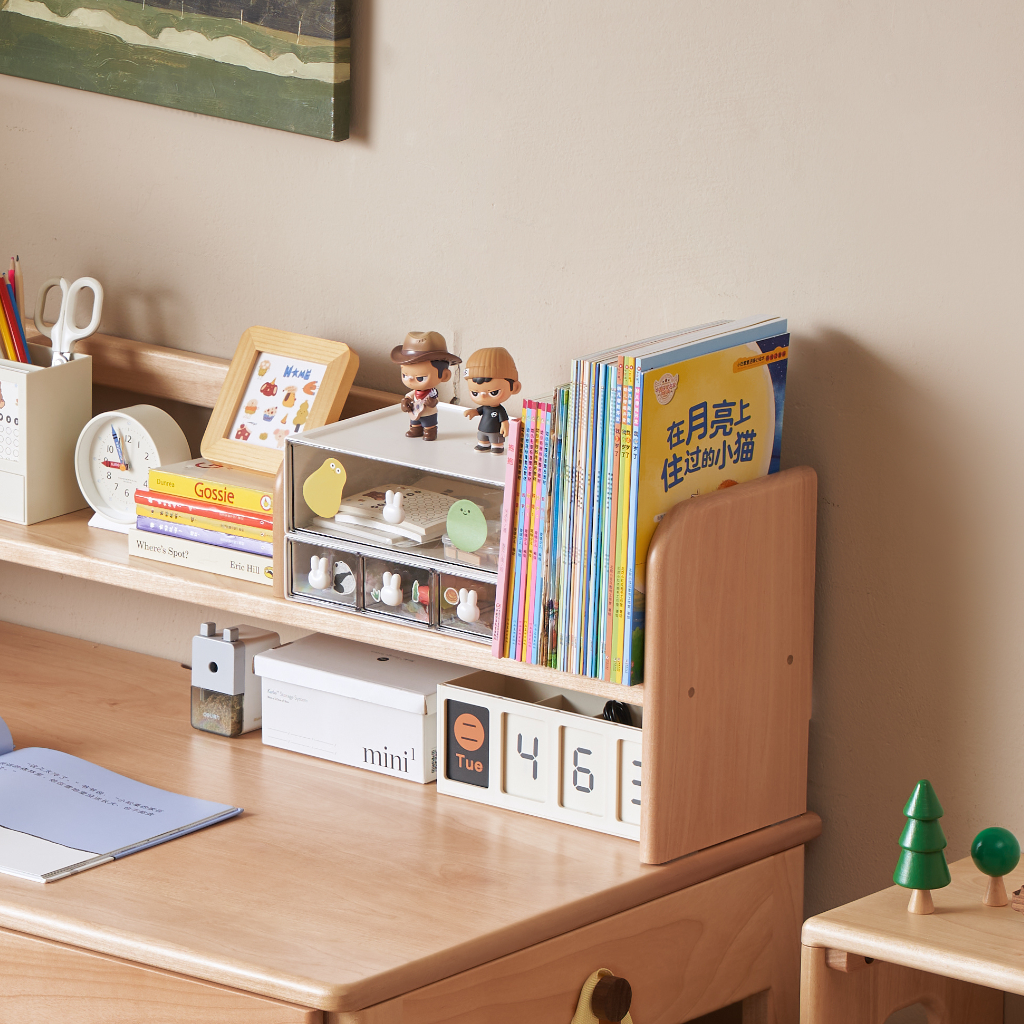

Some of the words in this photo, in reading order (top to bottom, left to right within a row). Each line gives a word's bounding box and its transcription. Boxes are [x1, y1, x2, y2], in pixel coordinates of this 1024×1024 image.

[666, 399, 752, 450] 在月亮上
[661, 429, 757, 493] 住过的小猫
[193, 482, 235, 504] Gossie
[136, 539, 167, 555] Where's
[168, 546, 189, 560] Spot?
[230, 560, 245, 572] Eric
[246, 564, 260, 575] Hill
[362, 746, 409, 773] mini
[455, 752, 484, 774] Tue
[516, 732, 538, 781] 4
[572, 746, 595, 794] 6
